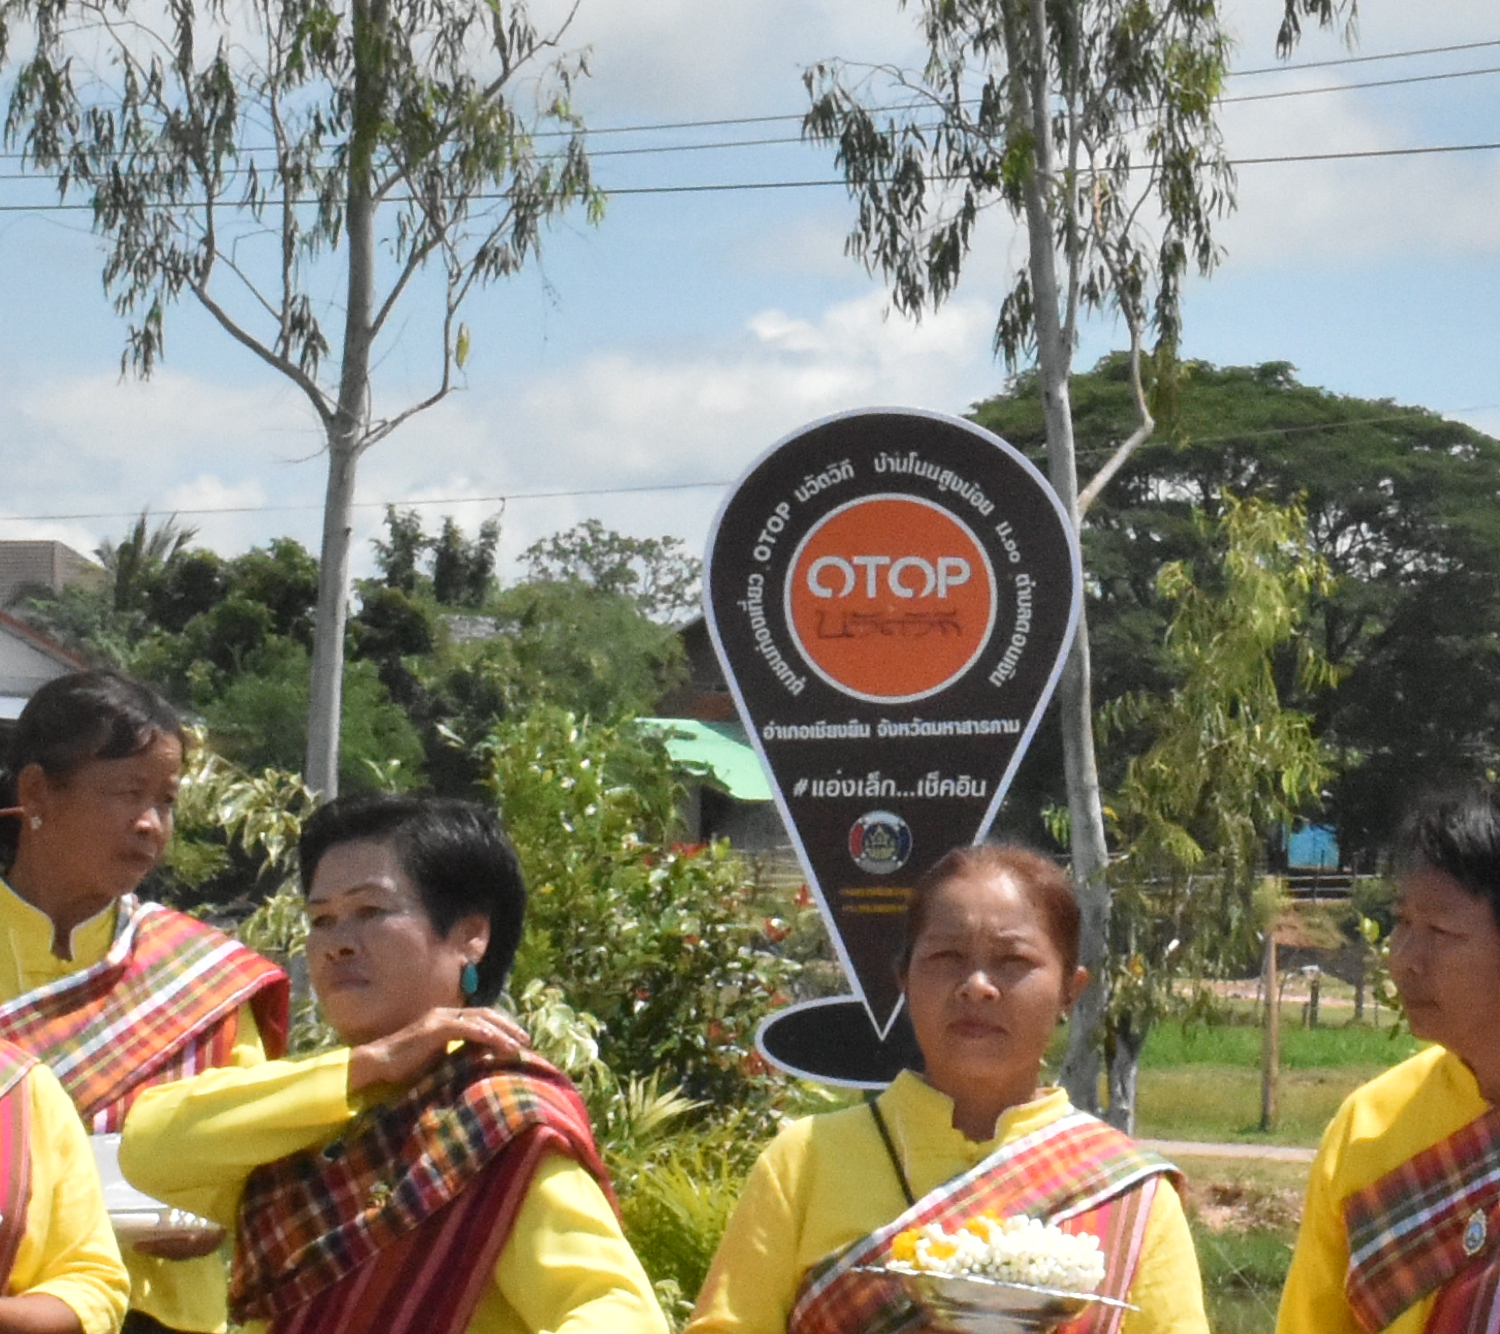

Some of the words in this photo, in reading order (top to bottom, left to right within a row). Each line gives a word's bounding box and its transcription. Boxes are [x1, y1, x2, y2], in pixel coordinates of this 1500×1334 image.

[793, 459, 855, 504] นวัตวิถี
[873, 451, 996, 517] บ้านโนนสูงน้อย
[753, 501, 791, 563] OTOP
[806, 554, 972, 599] OTOP
[739, 573, 807, 696] ชุมชนท่องเที่ยว
[988, 573, 1037, 688] ตำบลดอนเงิน
[876, 716, 1021, 738] จังหวัดมหาสารคาม
